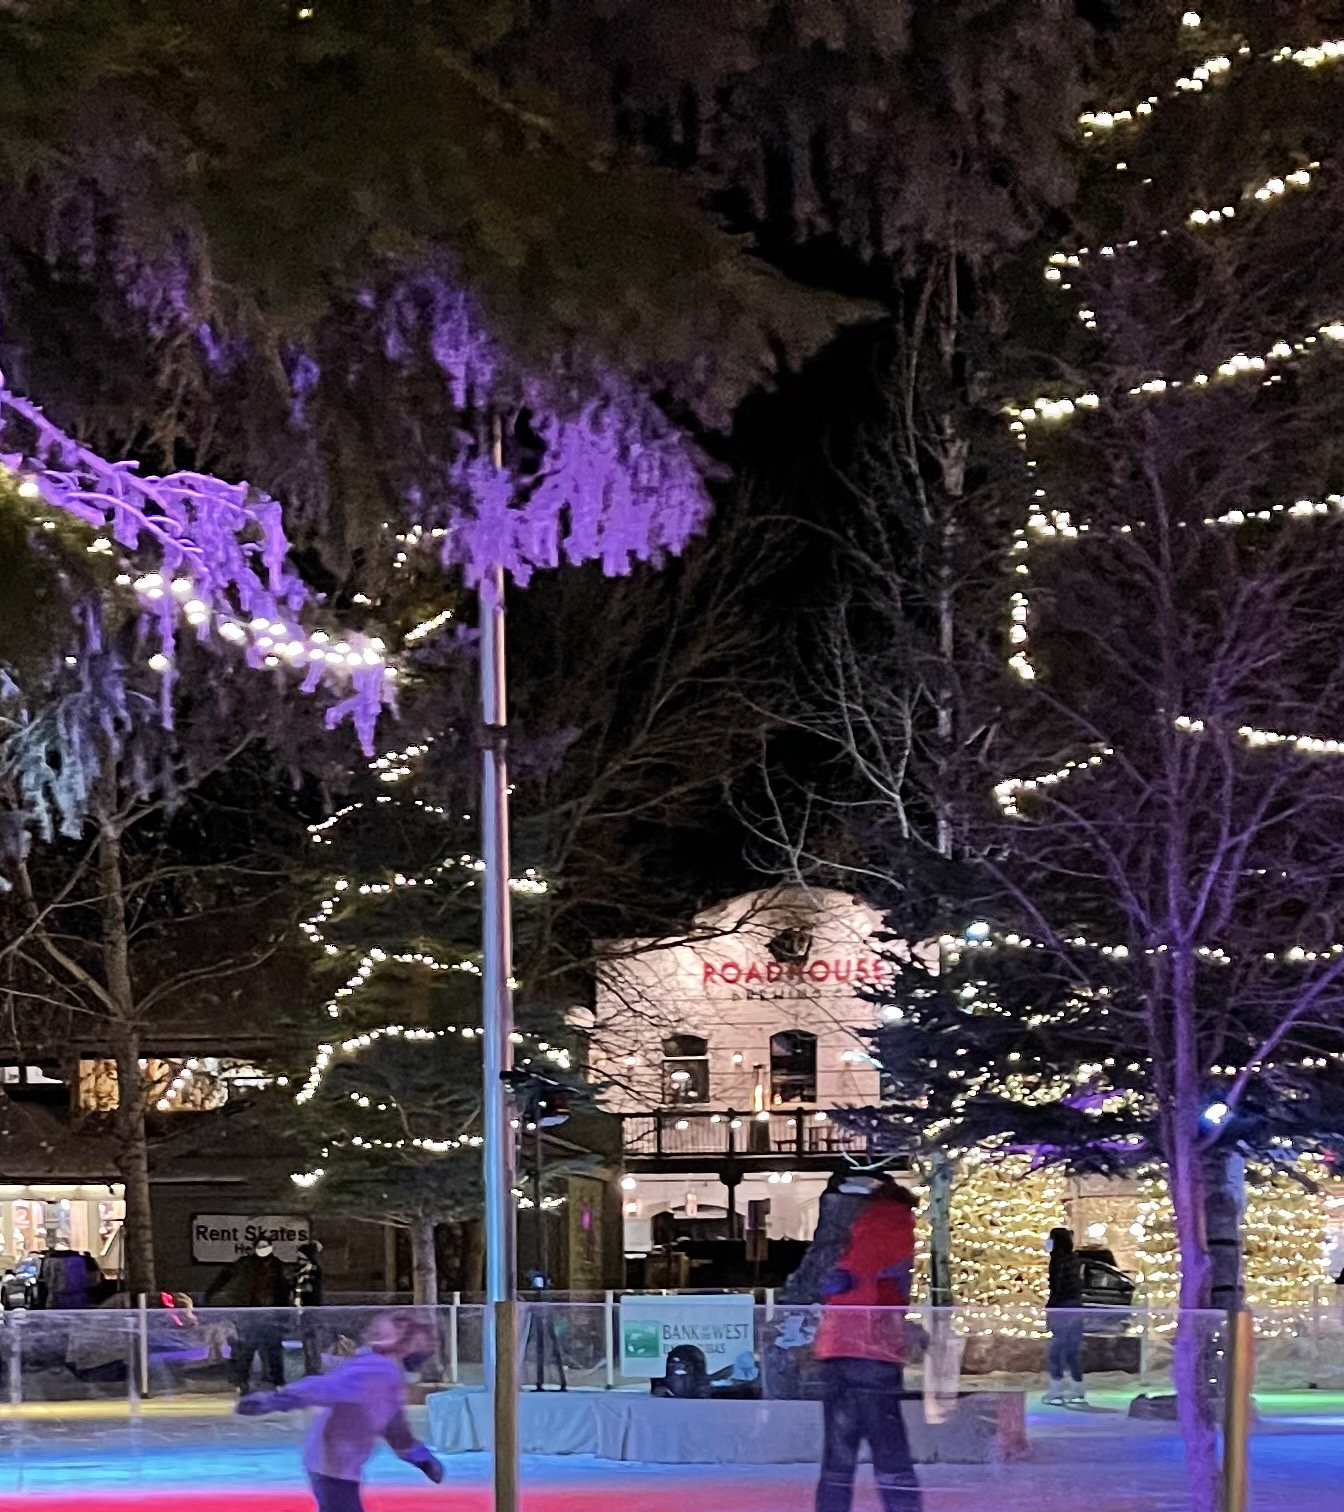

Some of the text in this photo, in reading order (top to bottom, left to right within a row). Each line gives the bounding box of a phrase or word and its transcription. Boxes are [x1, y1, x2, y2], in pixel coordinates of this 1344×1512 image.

[197, 1224, 308, 1242] Rent Skates
[662, 1323, 699, 1340] BANK
[713, 1322, 749, 1340] WEST
